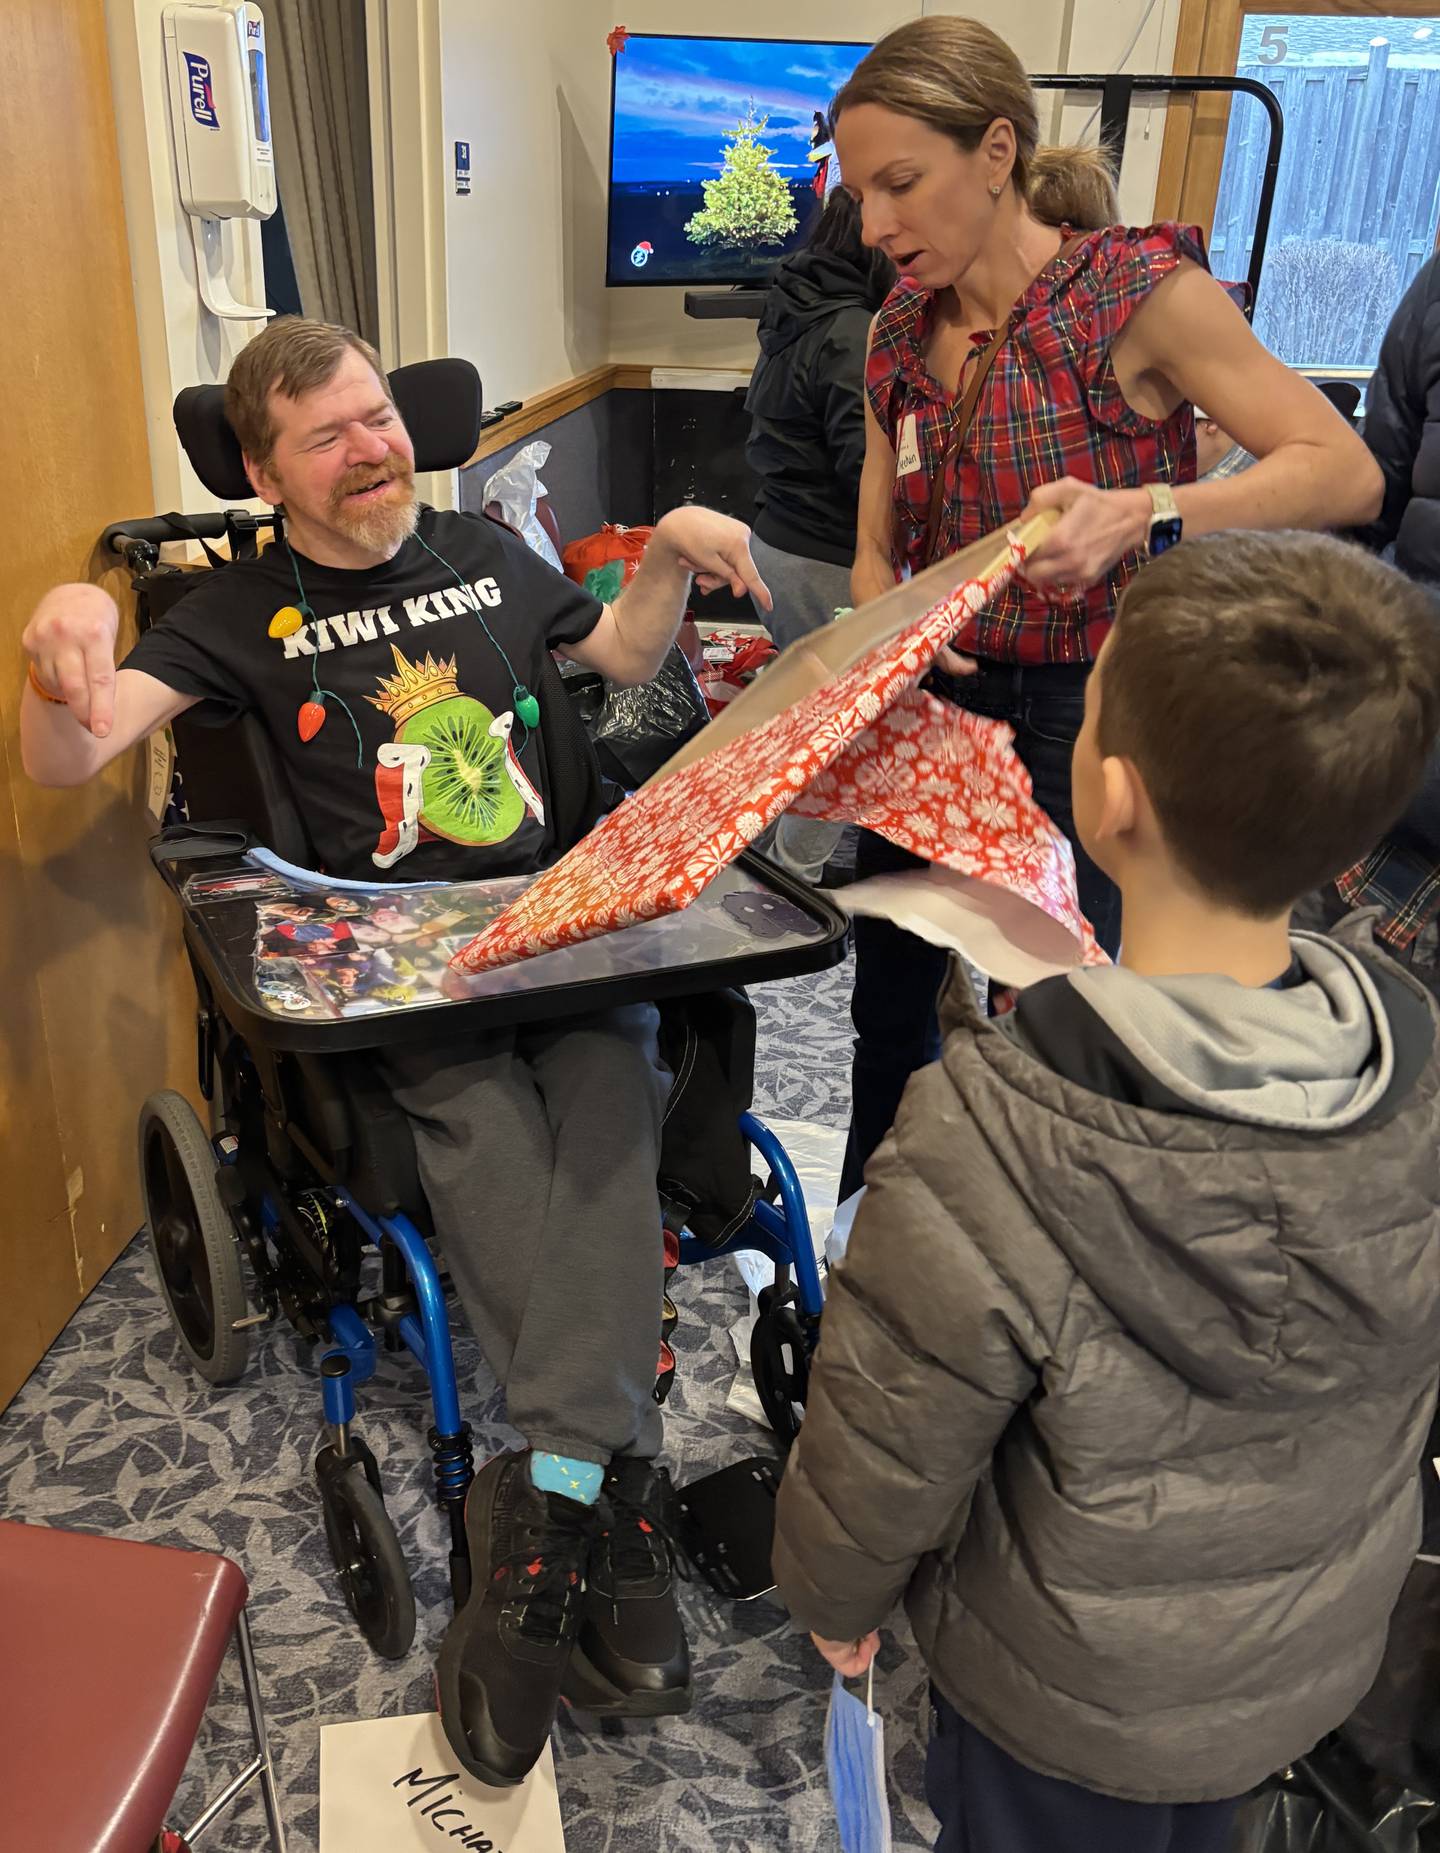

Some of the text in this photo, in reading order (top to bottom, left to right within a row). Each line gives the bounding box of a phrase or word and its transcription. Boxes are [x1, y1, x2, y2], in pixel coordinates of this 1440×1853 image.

[1257, 26, 1289, 65] 5
[190, 61, 213, 122] Purell
[282, 577, 503, 660] KIWI KING
